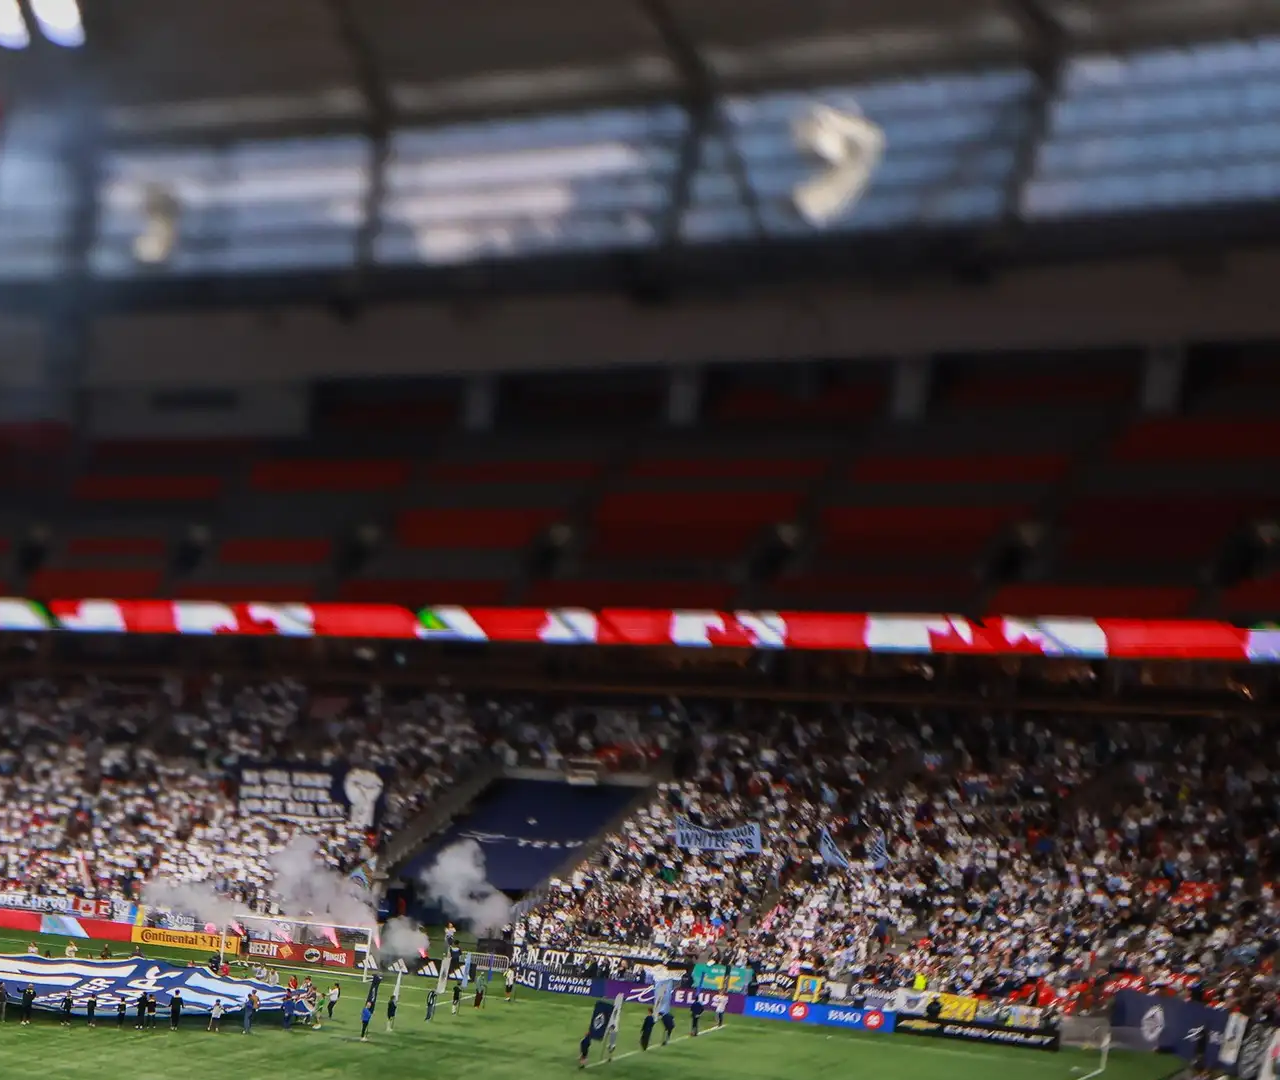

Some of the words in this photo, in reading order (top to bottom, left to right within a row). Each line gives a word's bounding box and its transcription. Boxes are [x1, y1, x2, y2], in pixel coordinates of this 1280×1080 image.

[679, 831, 755, 850] WHITECPS
[140, 928, 199, 946] Continental
[249, 941, 278, 957] HEEZ-IT
[322, 949, 347, 965] PRINGLES
[543, 949, 570, 969] CITY
[547, 983, 568, 993] LAW
[569, 985, 591, 995] FIRM
[548, 974, 593, 988] CANADA'S
[753, 1001, 787, 1014] BMO
[827, 1009, 862, 1023] BMO
[943, 1023, 1056, 1046] CHEVROLET
